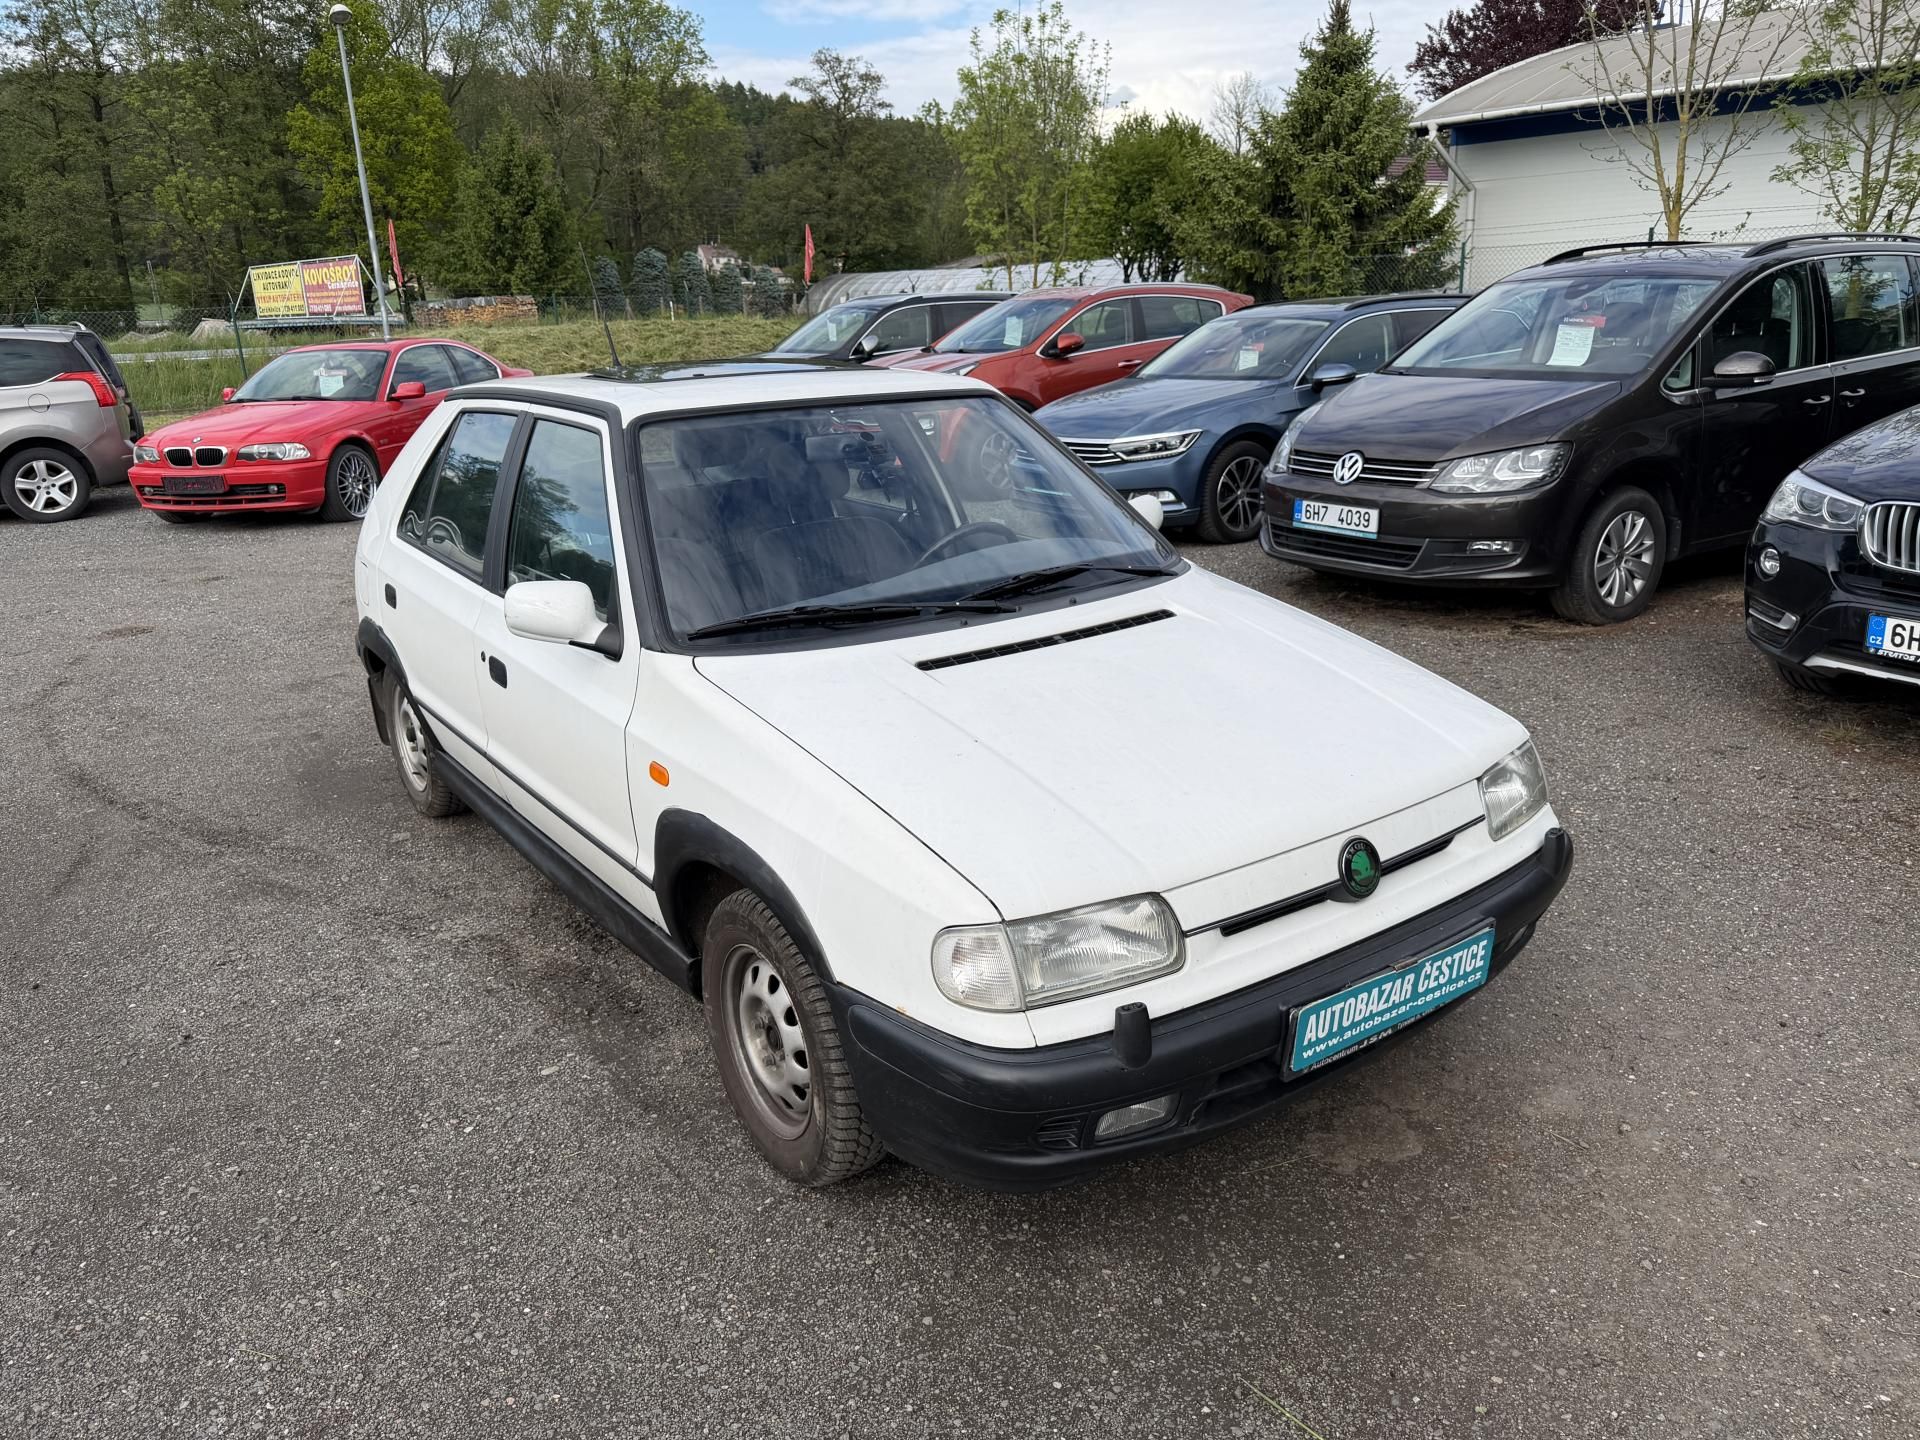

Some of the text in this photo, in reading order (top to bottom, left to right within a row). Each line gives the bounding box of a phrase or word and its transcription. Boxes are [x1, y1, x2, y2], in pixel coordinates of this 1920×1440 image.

[303, 262, 357, 286] KOVOŠROT
[1304, 503, 1371, 528] 6H7 4039
[1869, 635, 1882, 645] CZ
[1890, 623, 1920, 652] 6H
[1302, 972, 1415, 1046] AUTOBAZAR
[1417, 939, 1488, 993] ČESTICE
[1302, 971, 1482, 1059] www.autobazar-cestice.cz
[1310, 1044, 1359, 1071] Autocentrum
